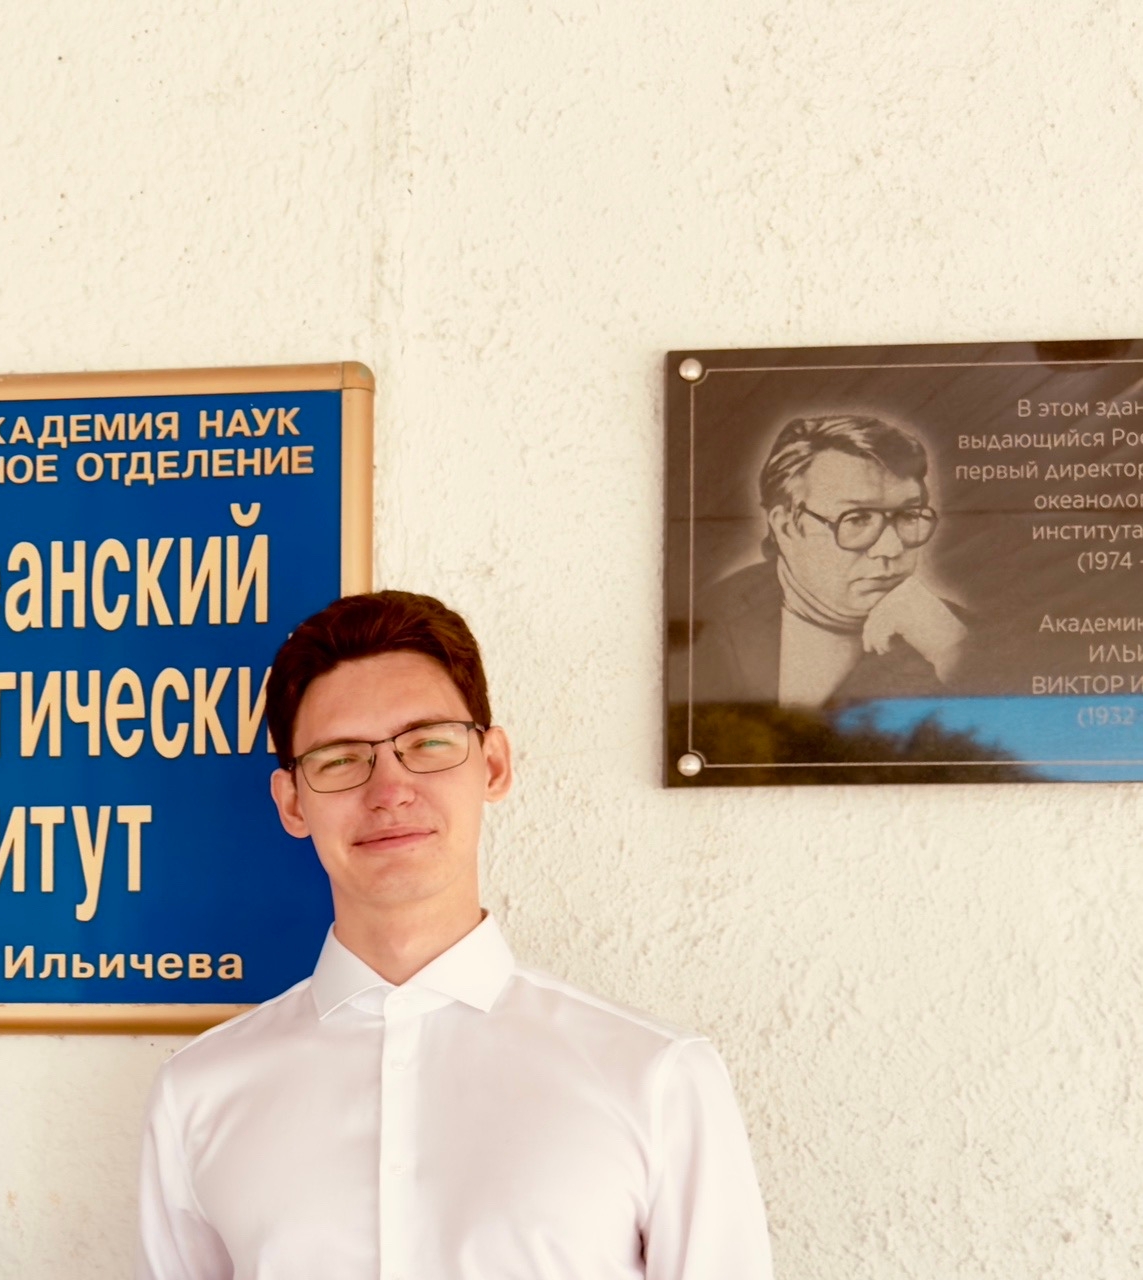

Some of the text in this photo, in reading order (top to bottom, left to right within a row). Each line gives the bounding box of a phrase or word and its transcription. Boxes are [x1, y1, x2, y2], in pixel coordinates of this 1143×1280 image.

[1017, 398, 1032, 418] В
[1037, 401, 1089, 418] этом
[199, 407, 301, 439] НАУК
[957, 428, 1105, 451] выдающийся
[76, 445, 315, 486] ОТДЕЛЕНИЕ
[955, 460, 1039, 482] первый
[1031, 524, 1143, 543] института
[1076, 551, 1133, 573] (1974
[1031, 674, 1124, 695] ВИКТОР
[4, 945, 244, 980] Ильичева
